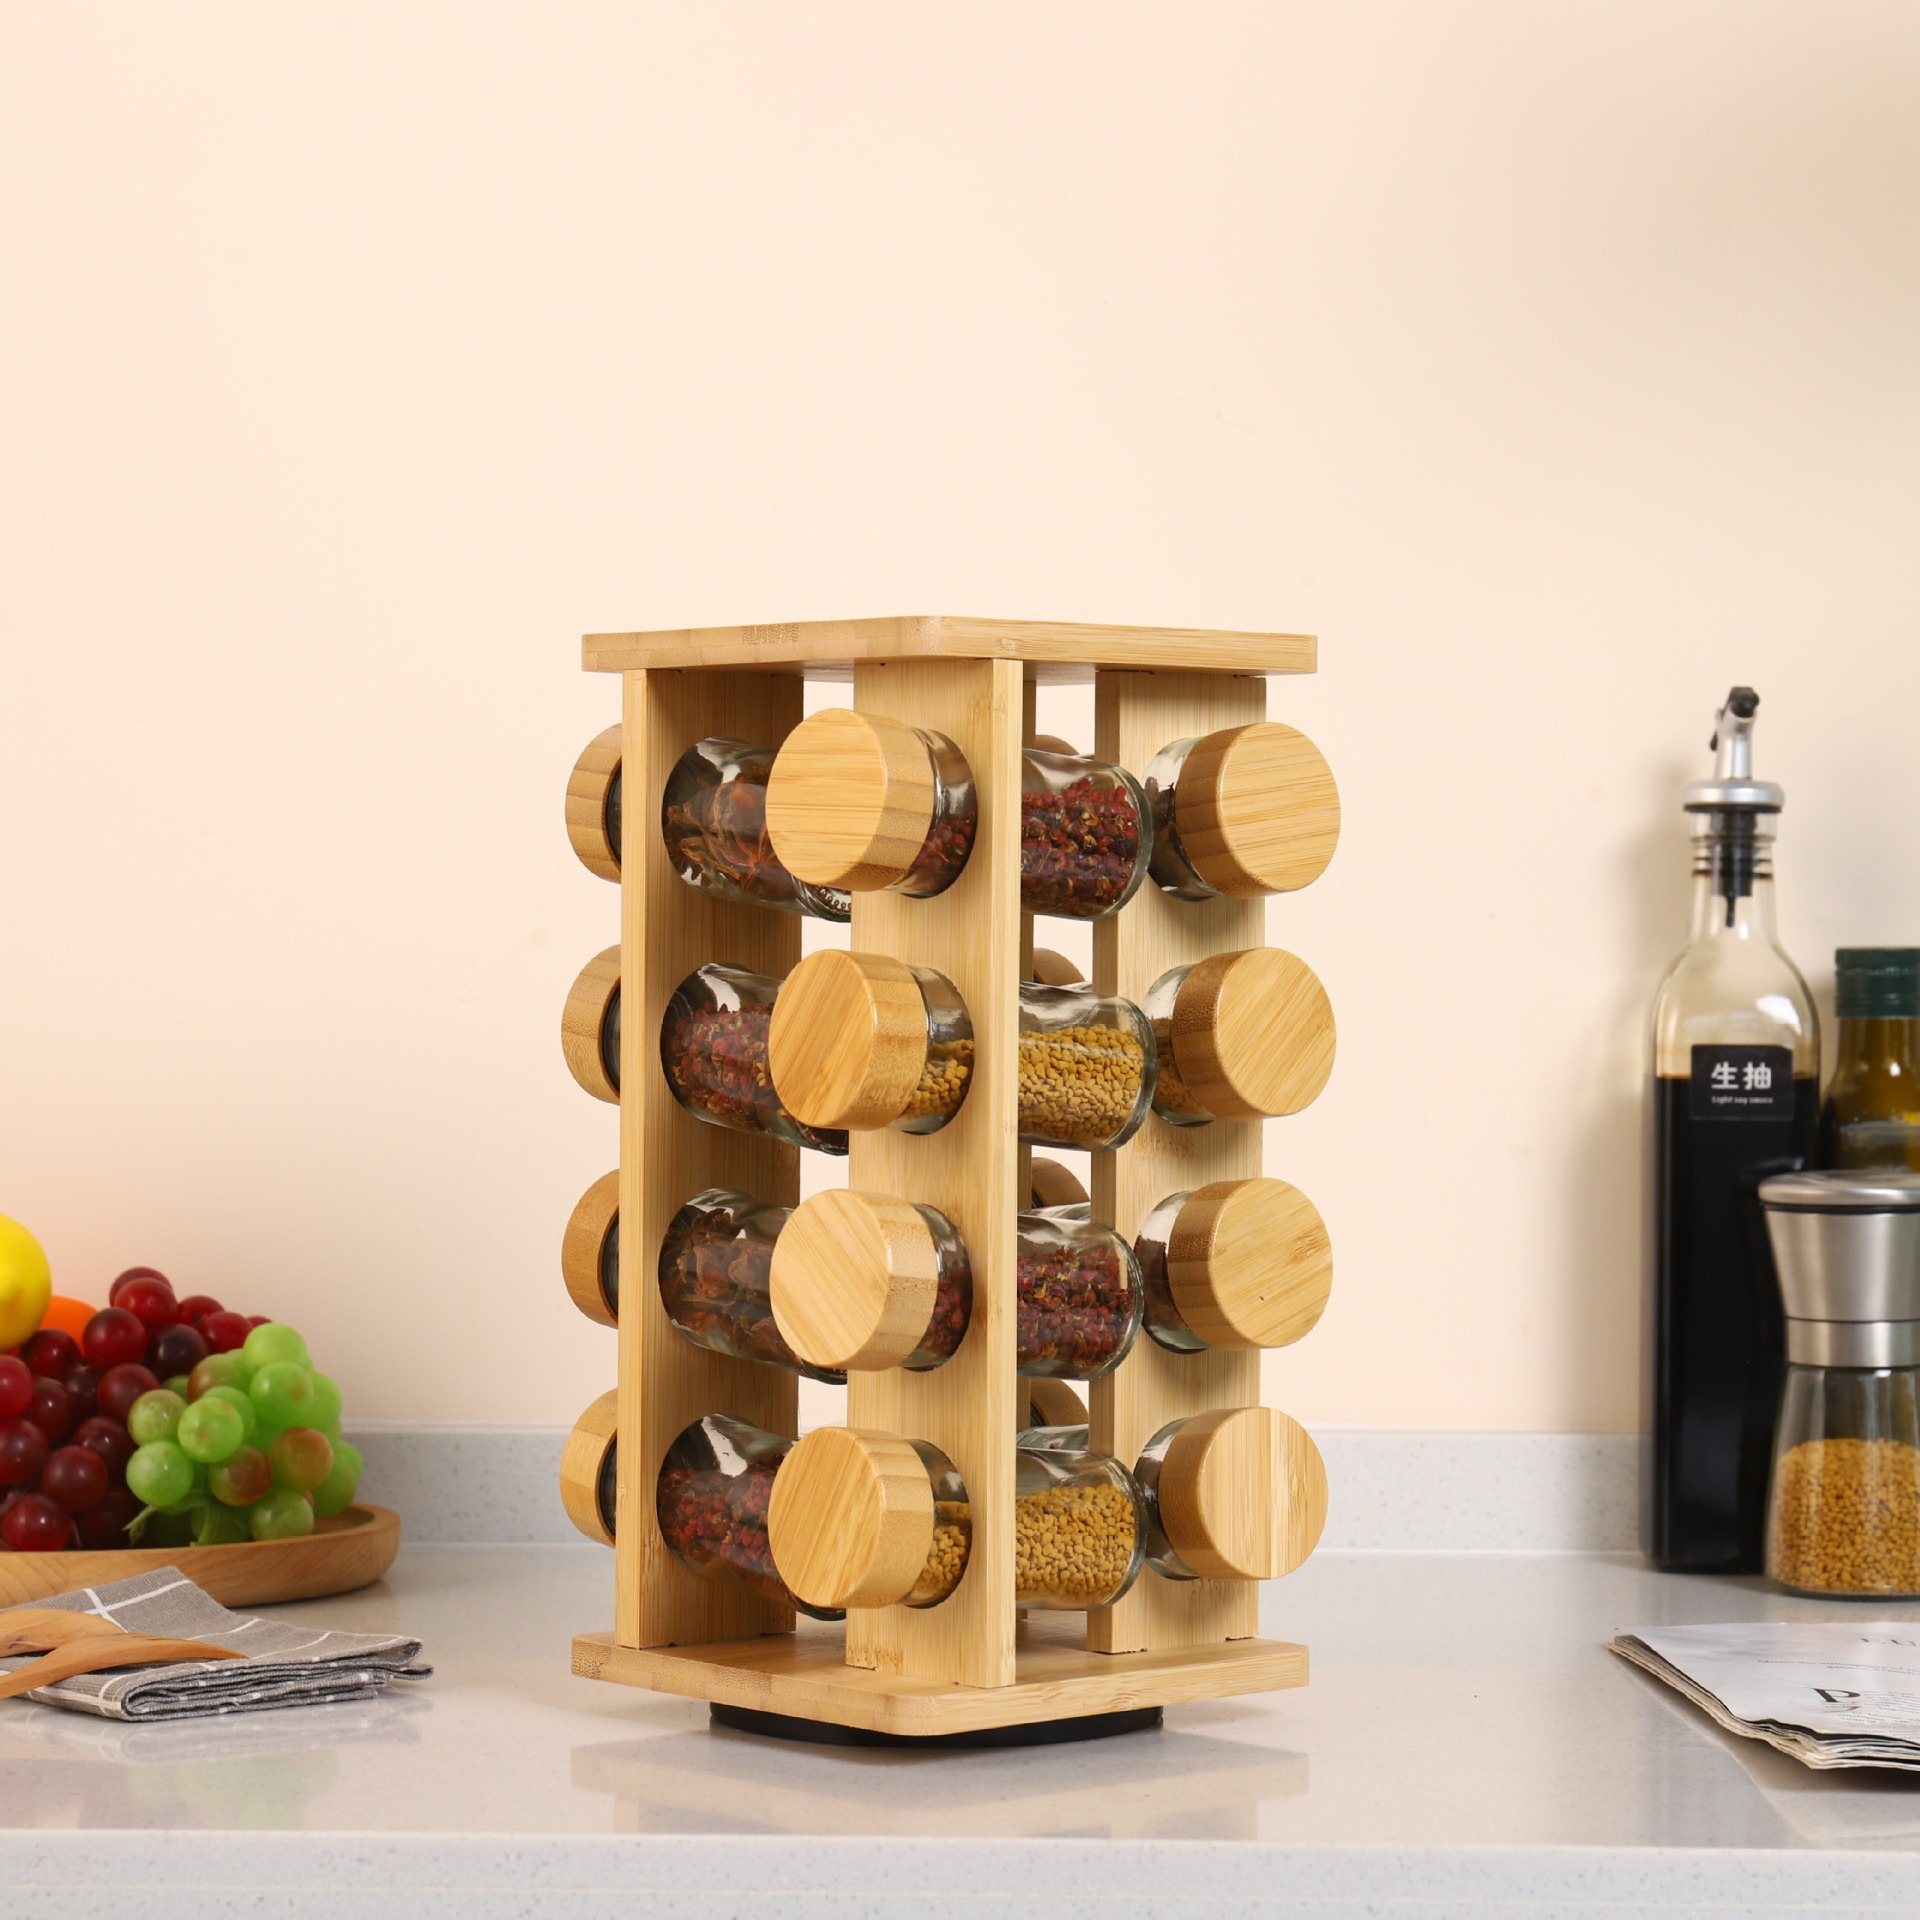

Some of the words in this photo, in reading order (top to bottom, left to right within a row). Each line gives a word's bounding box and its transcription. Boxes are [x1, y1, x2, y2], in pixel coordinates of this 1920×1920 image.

[1711, 1061, 1772, 1090] 生抽
[1711, 1095, 1733, 1105] Light
[1749, 1096, 1774, 1104] sauce
